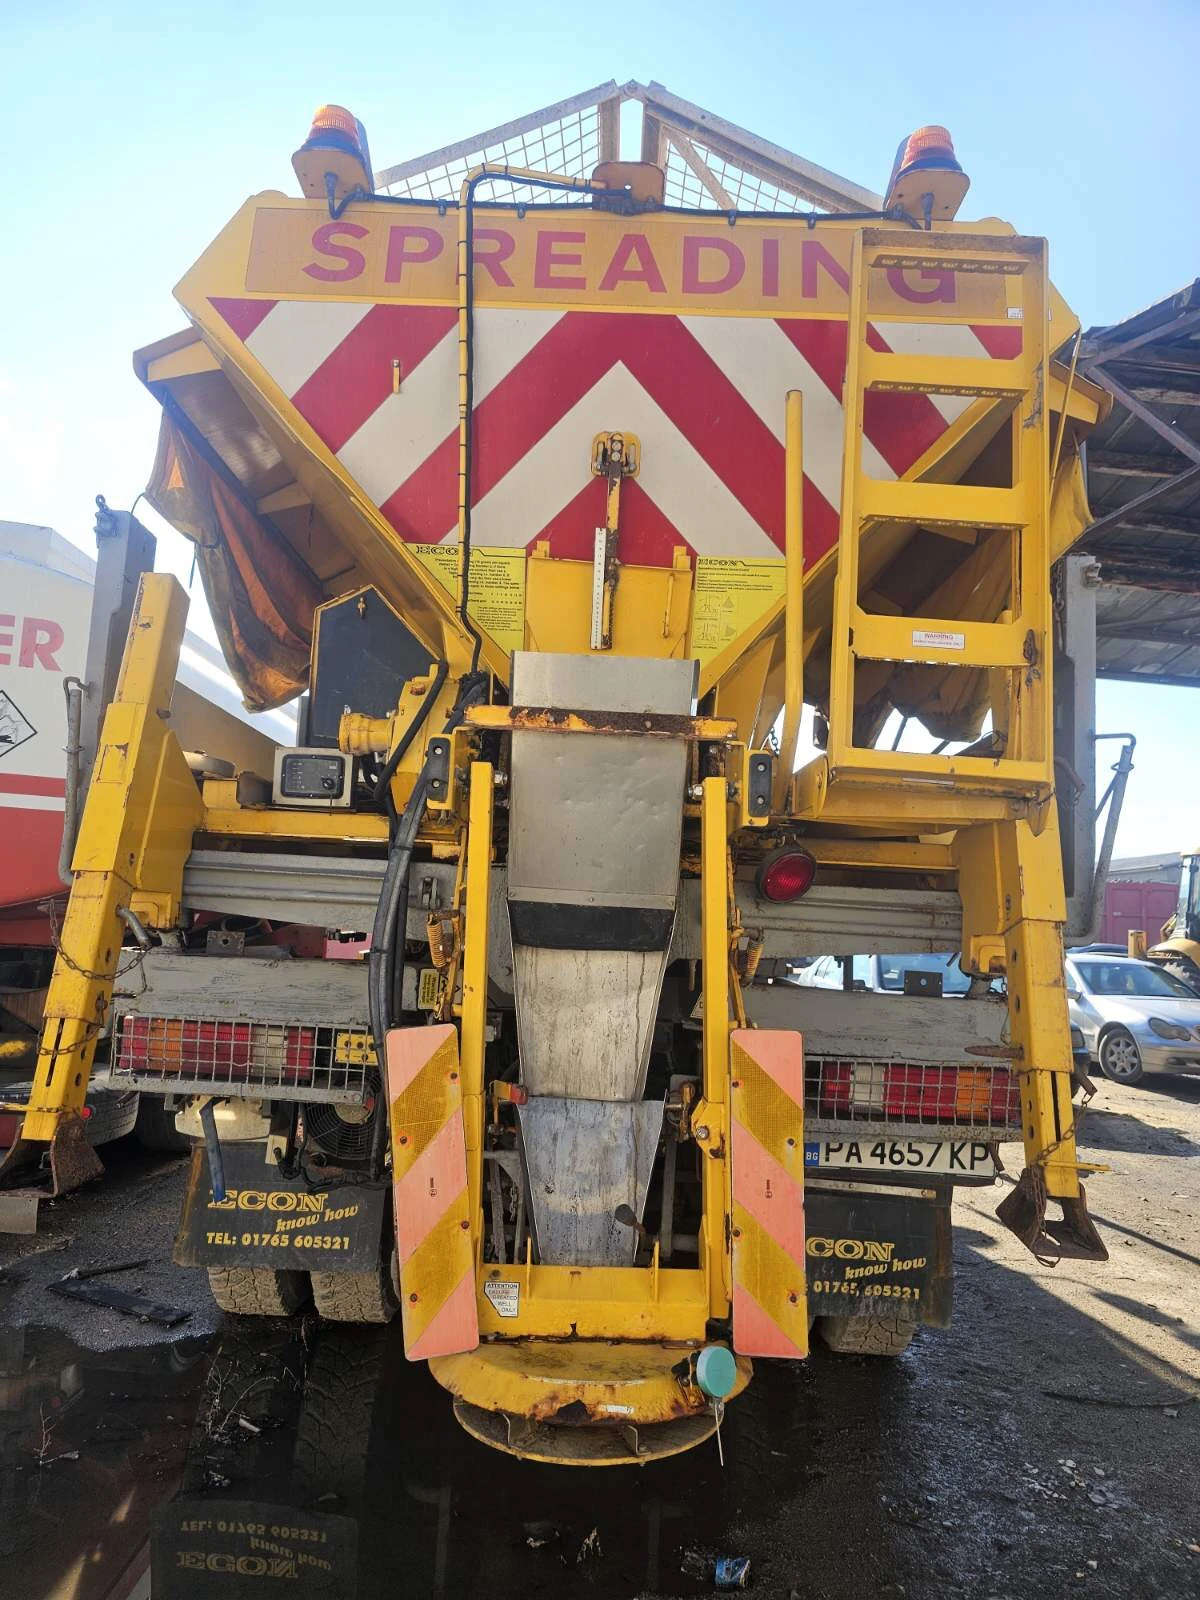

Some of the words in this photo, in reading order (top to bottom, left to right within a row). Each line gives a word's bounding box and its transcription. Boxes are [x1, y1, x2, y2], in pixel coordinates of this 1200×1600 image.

[302, 222, 957, 303] SPREADING
[416, 546, 471, 556] ECO
[806, 1151, 819, 1161] BG
[824, 1142, 863, 1164] PA
[870, 1142, 943, 1167] 4657
[949, 1142, 991, 1171] KP
[207, 1190, 328, 1212] ECON
[275, 1214, 320, 1233] know
[324, 1205, 359, 1222] how
[206, 1232, 237, 1245] TEL:
[241, 1233, 289, 1247] 01765
[294, 1235, 350, 1250] 605321
[805, 1237, 895, 1262] CON
[844, 1263, 888, 1280] know
[892, 1256, 927, 1272] how
[864, 1284, 920, 1300] 605321
